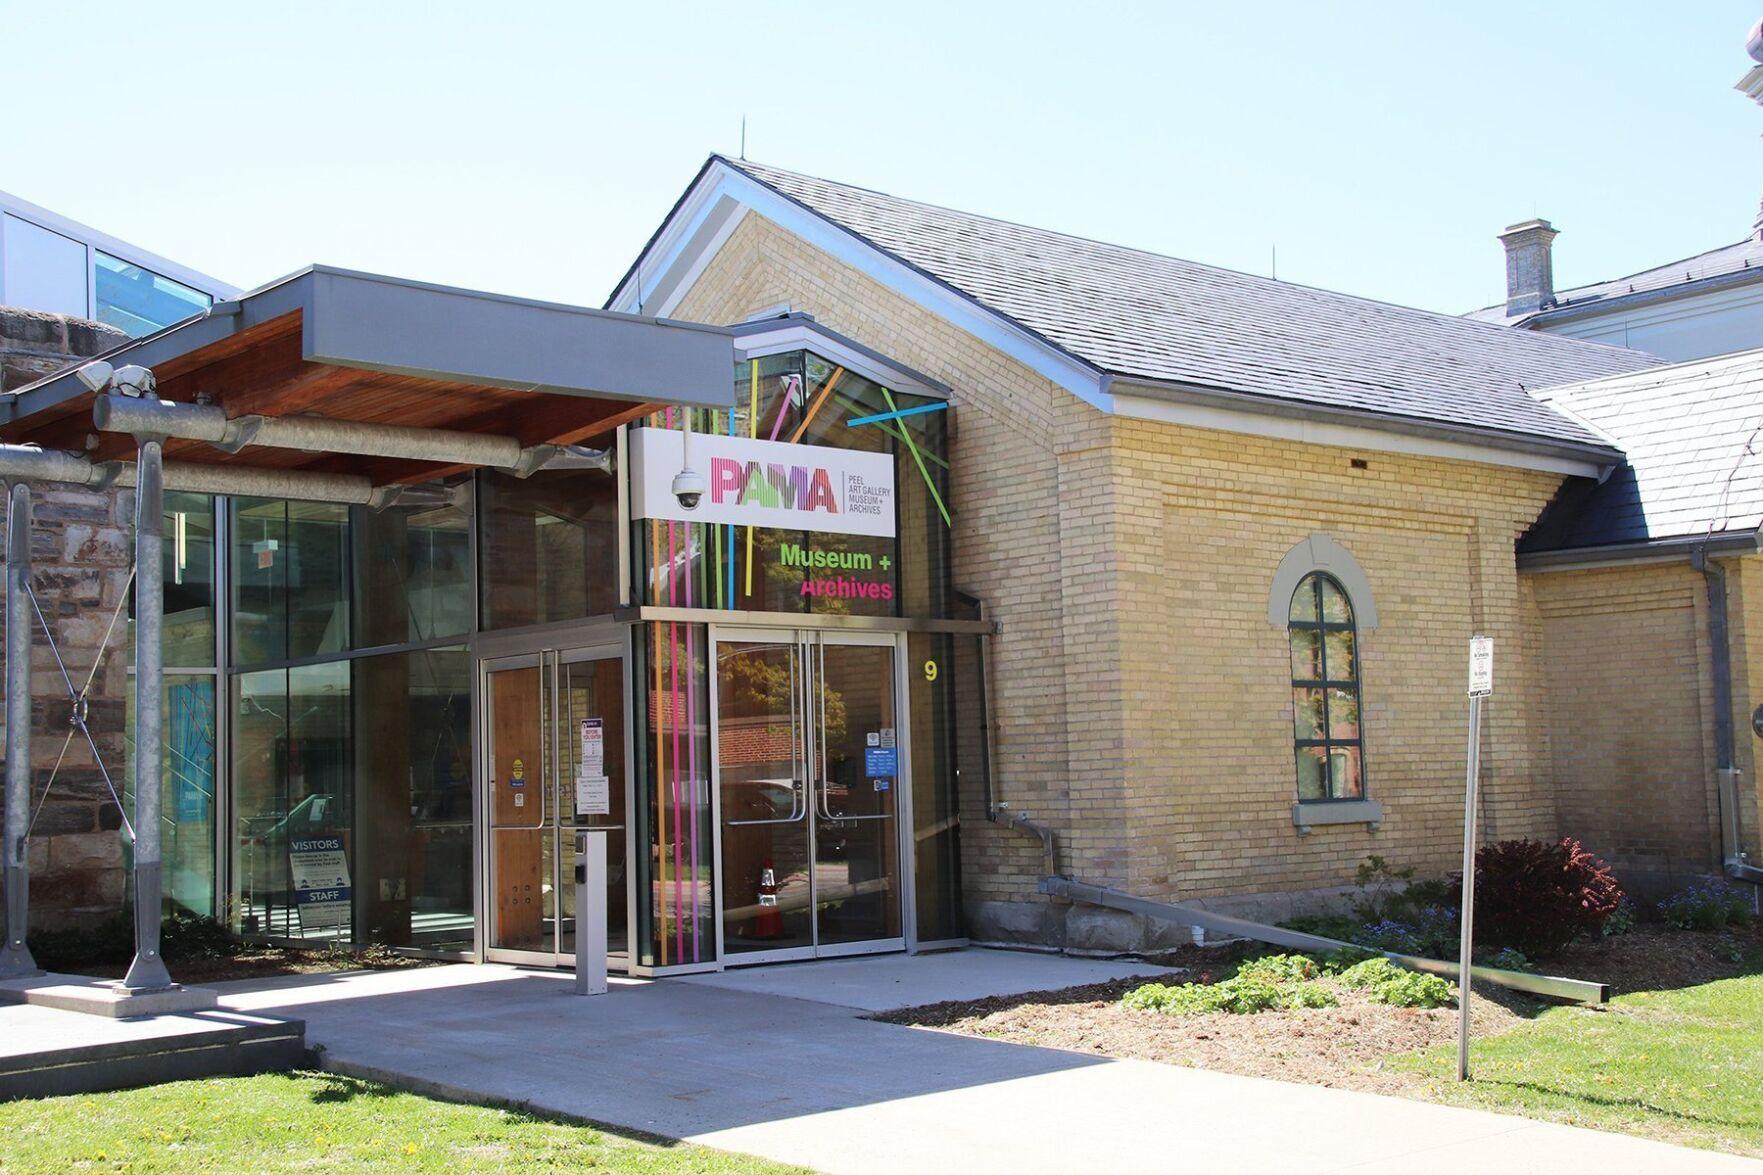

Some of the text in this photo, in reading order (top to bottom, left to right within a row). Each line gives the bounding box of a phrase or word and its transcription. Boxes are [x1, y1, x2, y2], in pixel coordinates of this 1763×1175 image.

[711, 457, 838, 513] PAMA
[848, 475, 864, 485] PEEL
[848, 485, 890, 497] ART GALLERY
[848, 494, 879, 505] MUSEUM
[849, 505, 881, 515] ARCHIVES
[780, 543, 891, 570] Museum +
[800, 576, 892, 599] Archives
[924, 660, 938, 681] 9
[291, 839, 339, 851] VISITORS
[309, 890, 340, 902] STAFF
